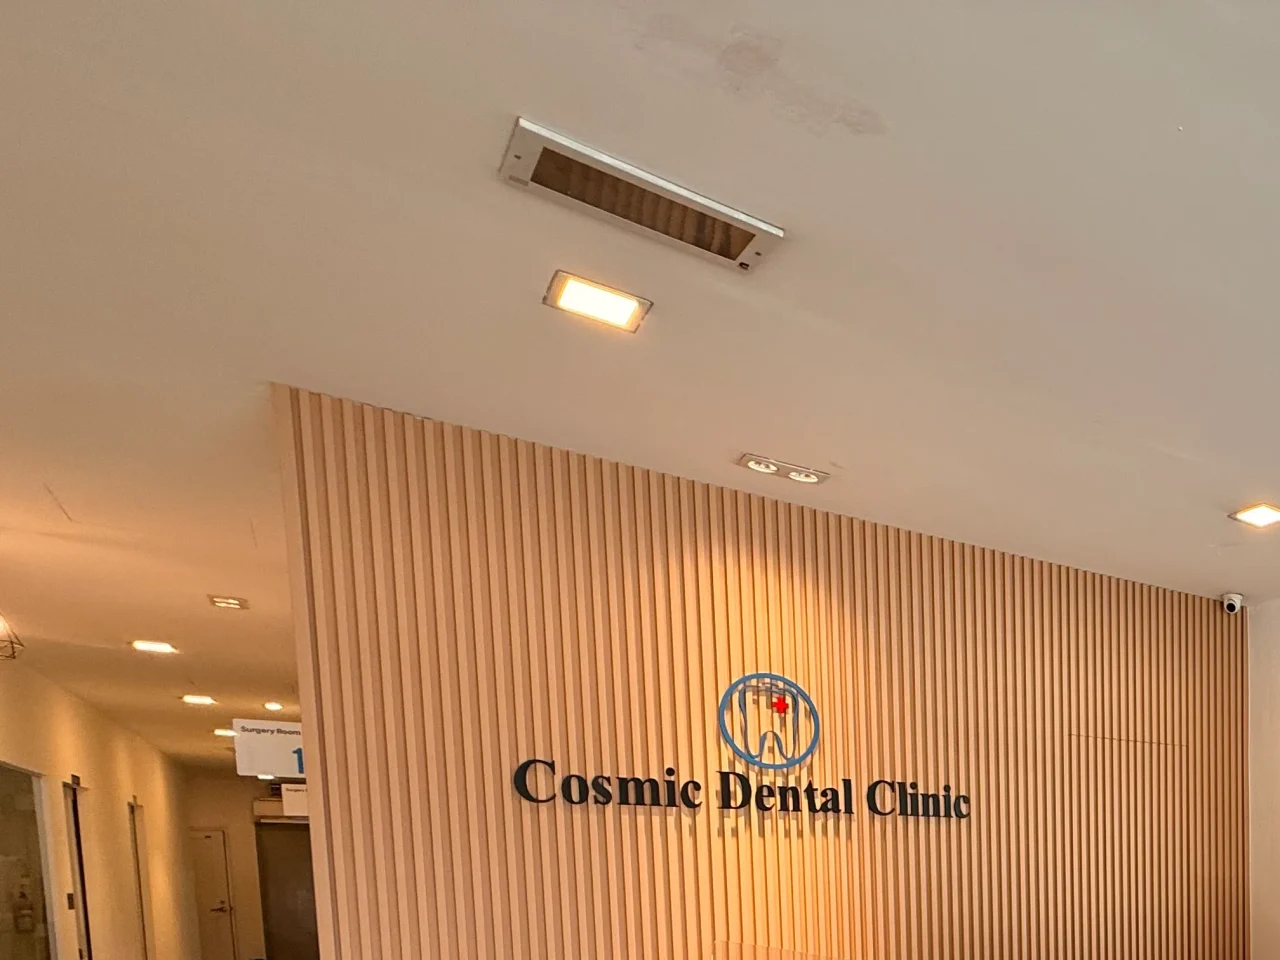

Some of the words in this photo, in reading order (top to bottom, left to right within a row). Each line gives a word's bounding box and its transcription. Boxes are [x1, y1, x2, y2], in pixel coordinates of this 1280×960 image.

[241, 725, 275, 735] Surgery
[276, 728, 301, 736] Room
[292, 747, 304, 774] 1
[513, 758, 702, 808] Cosmic
[717, 770, 855, 815] Dental
[867, 780, 971, 819] Clinic
